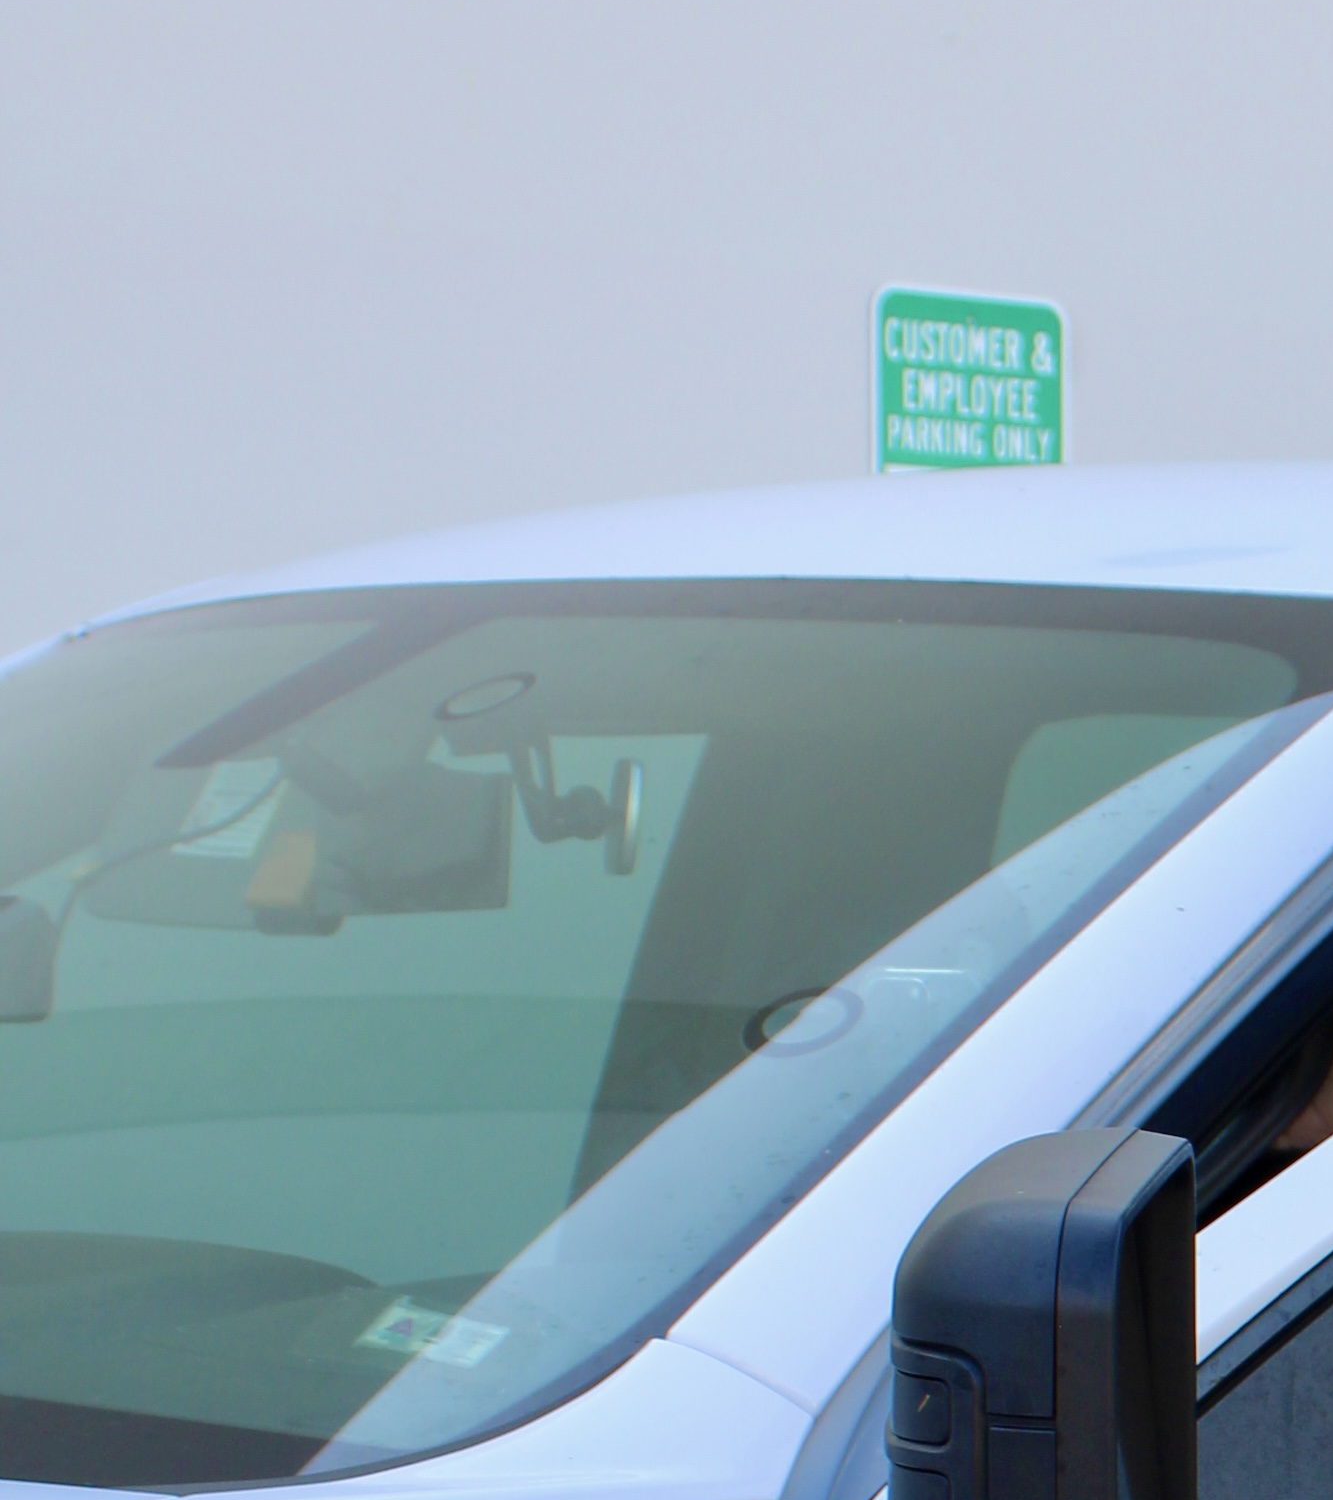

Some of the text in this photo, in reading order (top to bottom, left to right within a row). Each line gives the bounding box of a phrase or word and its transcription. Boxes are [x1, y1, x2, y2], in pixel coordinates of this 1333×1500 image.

[883, 316, 1055, 376] CUSTOMER &
[902, 367, 1040, 421] EMPLOYEE
[887, 414, 1053, 462] PARKING ONLY
